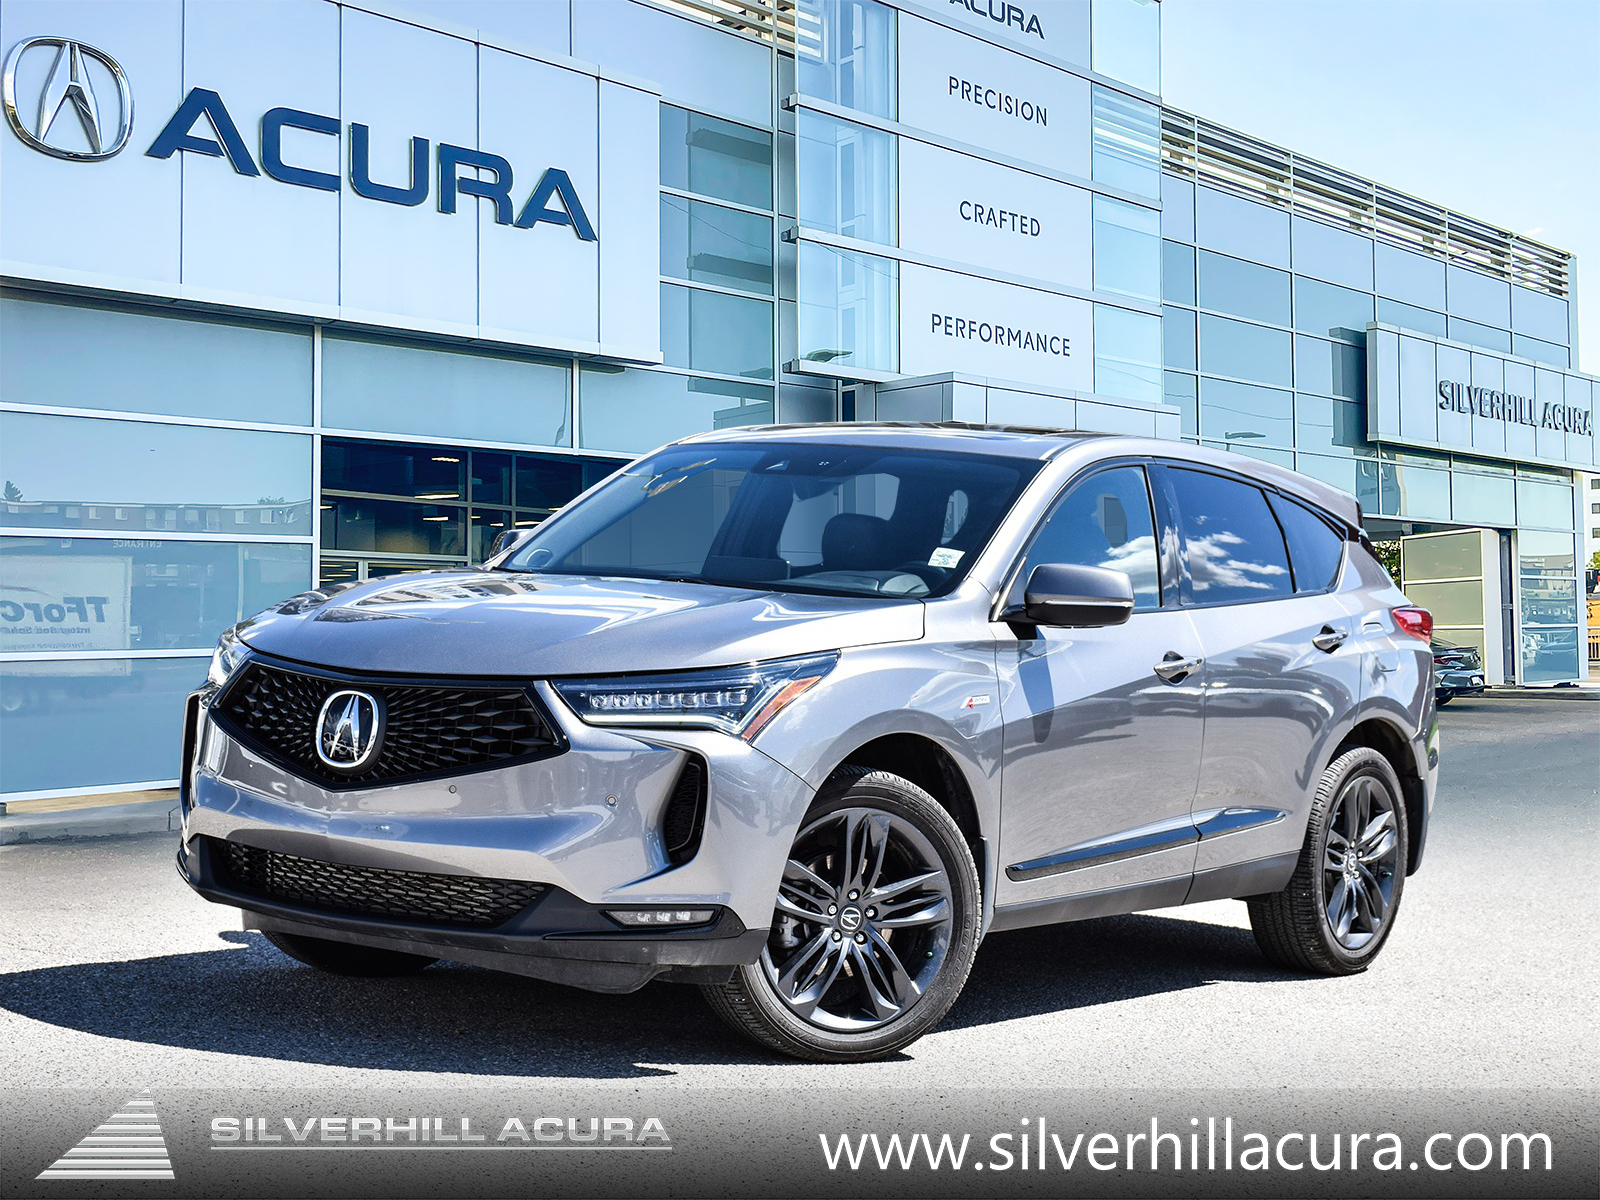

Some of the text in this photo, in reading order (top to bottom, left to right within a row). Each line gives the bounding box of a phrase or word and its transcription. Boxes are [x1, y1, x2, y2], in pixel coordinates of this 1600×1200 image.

[948, 75, 1048, 126] PRECISION
[145, 87, 597, 241] ACURA
[959, 200, 1041, 237] CRAFTED
[931, 313, 1071, 357] PERFORMANCE
[1439, 379, 1594, 437] SILVERHILL ACURA
